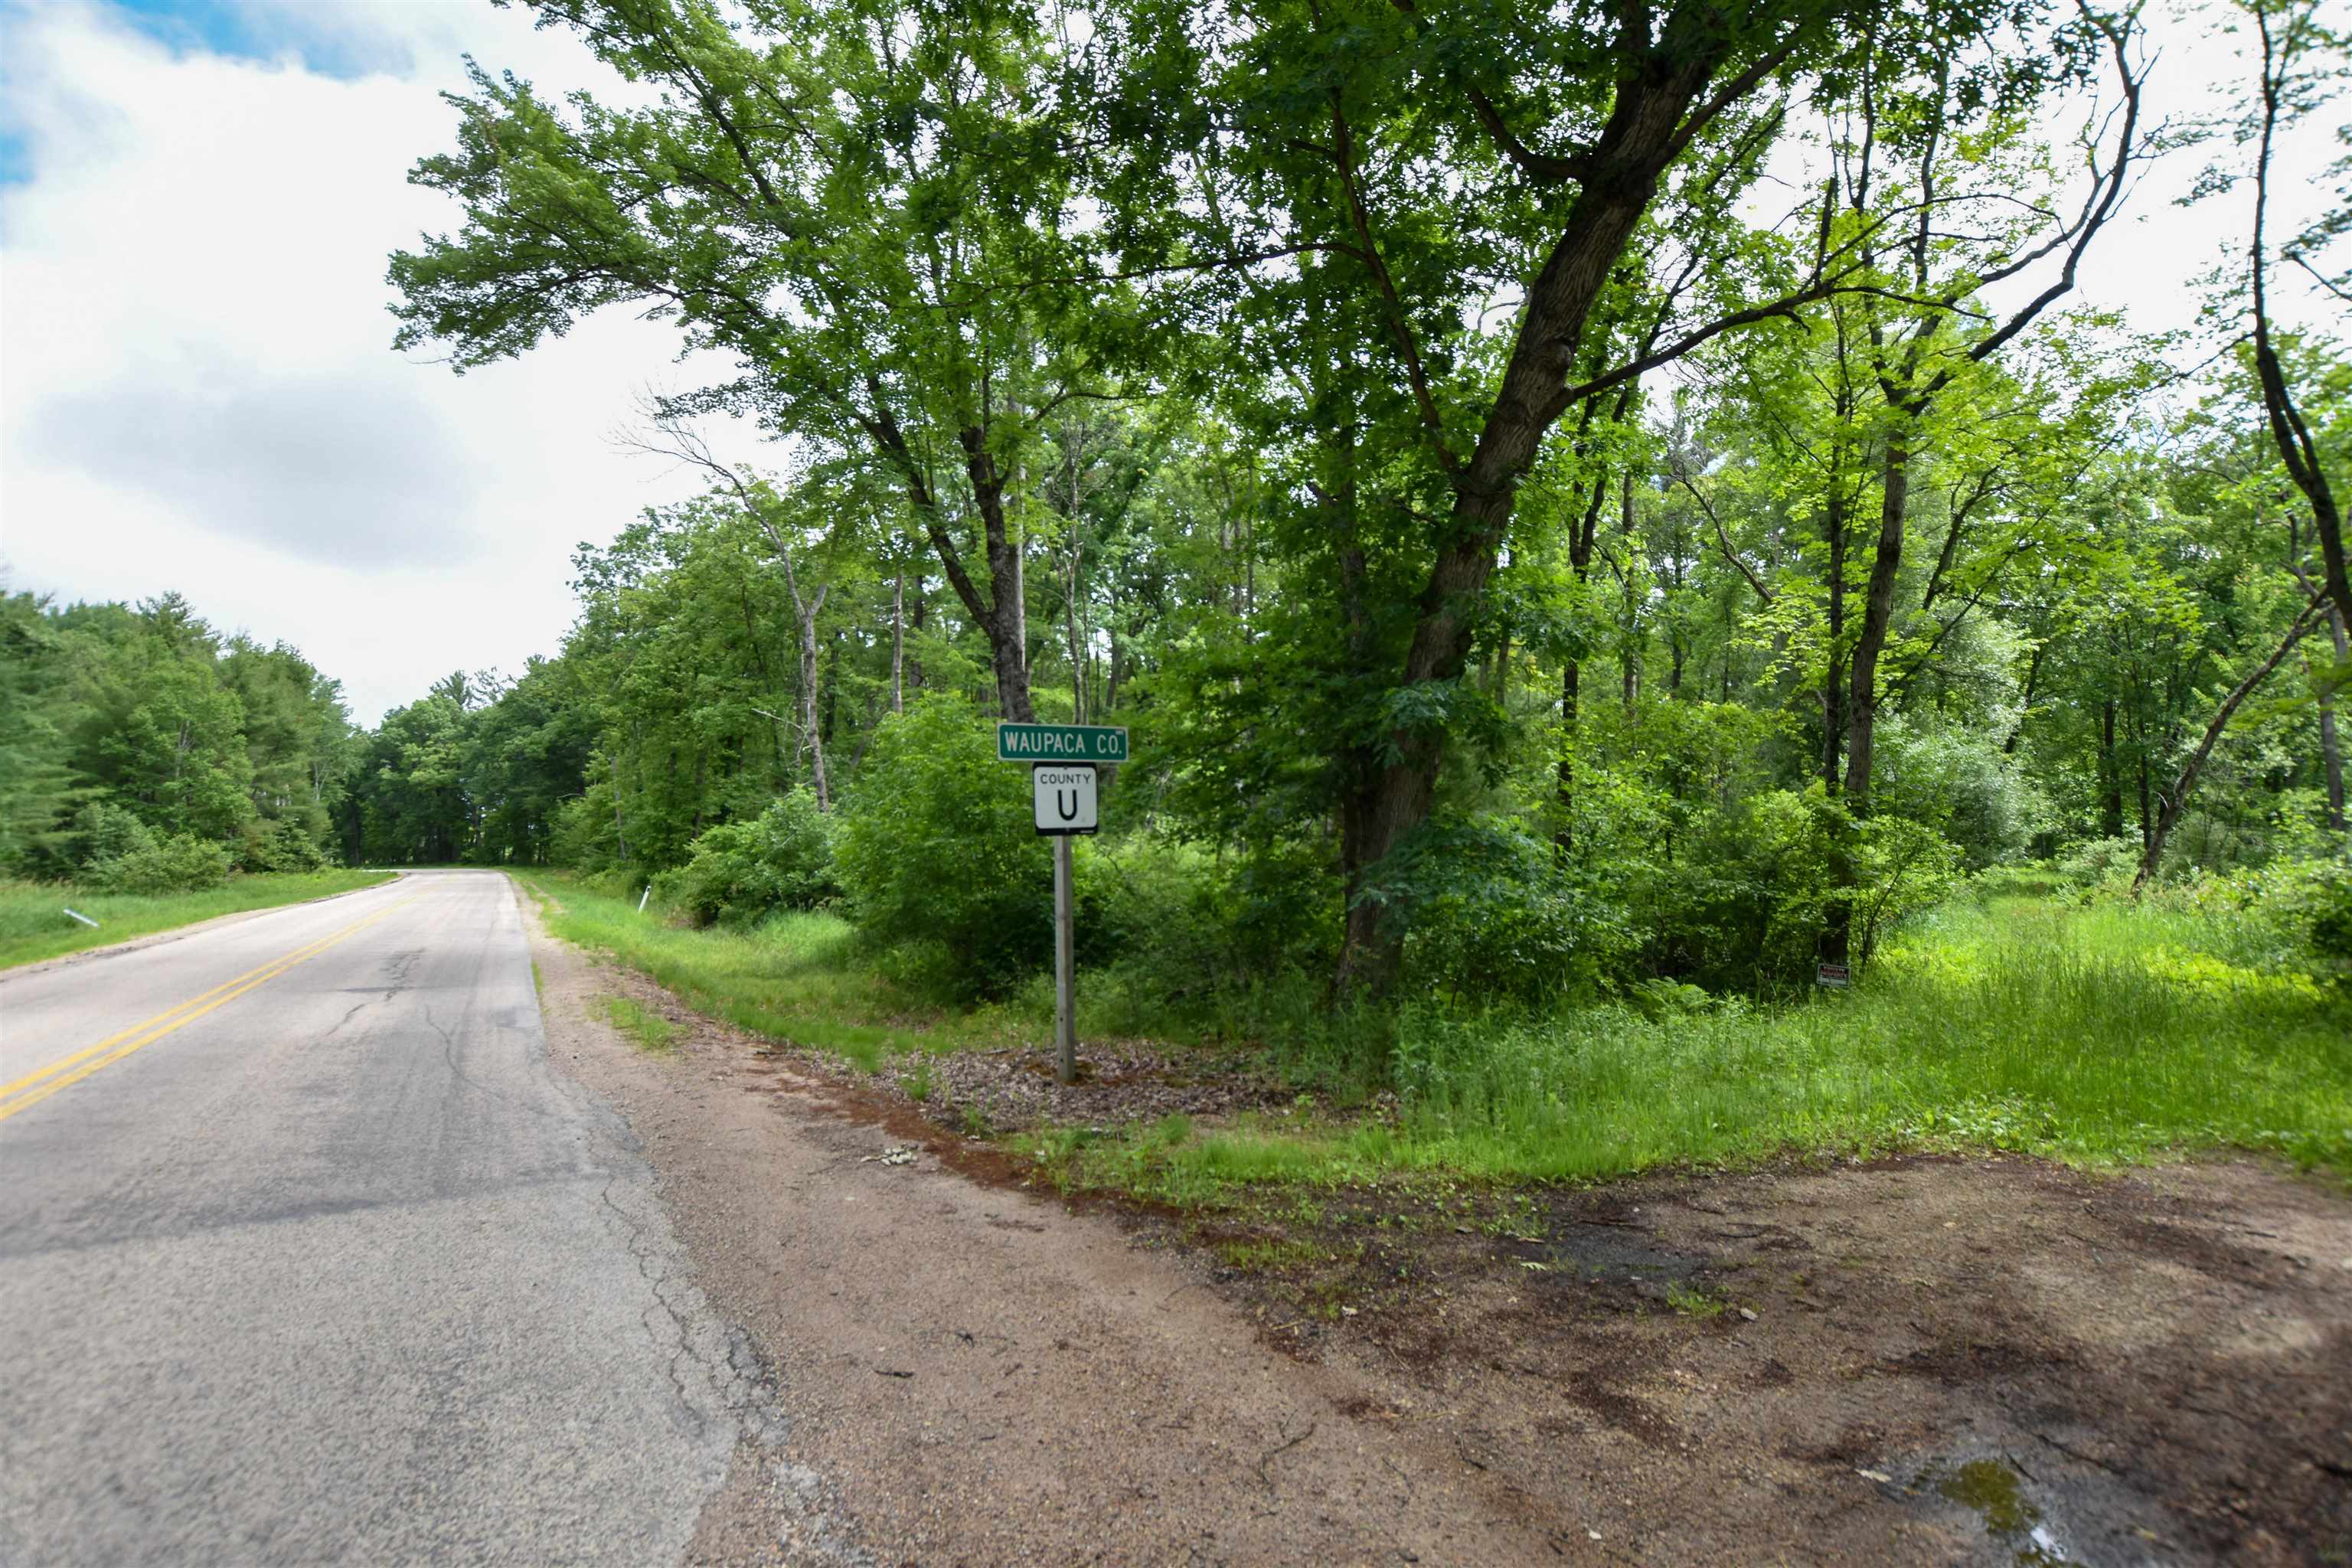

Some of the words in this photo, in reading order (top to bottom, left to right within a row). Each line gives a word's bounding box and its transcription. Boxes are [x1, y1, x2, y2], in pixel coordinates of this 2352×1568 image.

[1004, 731, 1086, 753] WAUPACA
[1096, 734, 1122, 754] CO.
[1040, 773, 1091, 784] COUNTY
[1057, 789, 1077, 821] U
